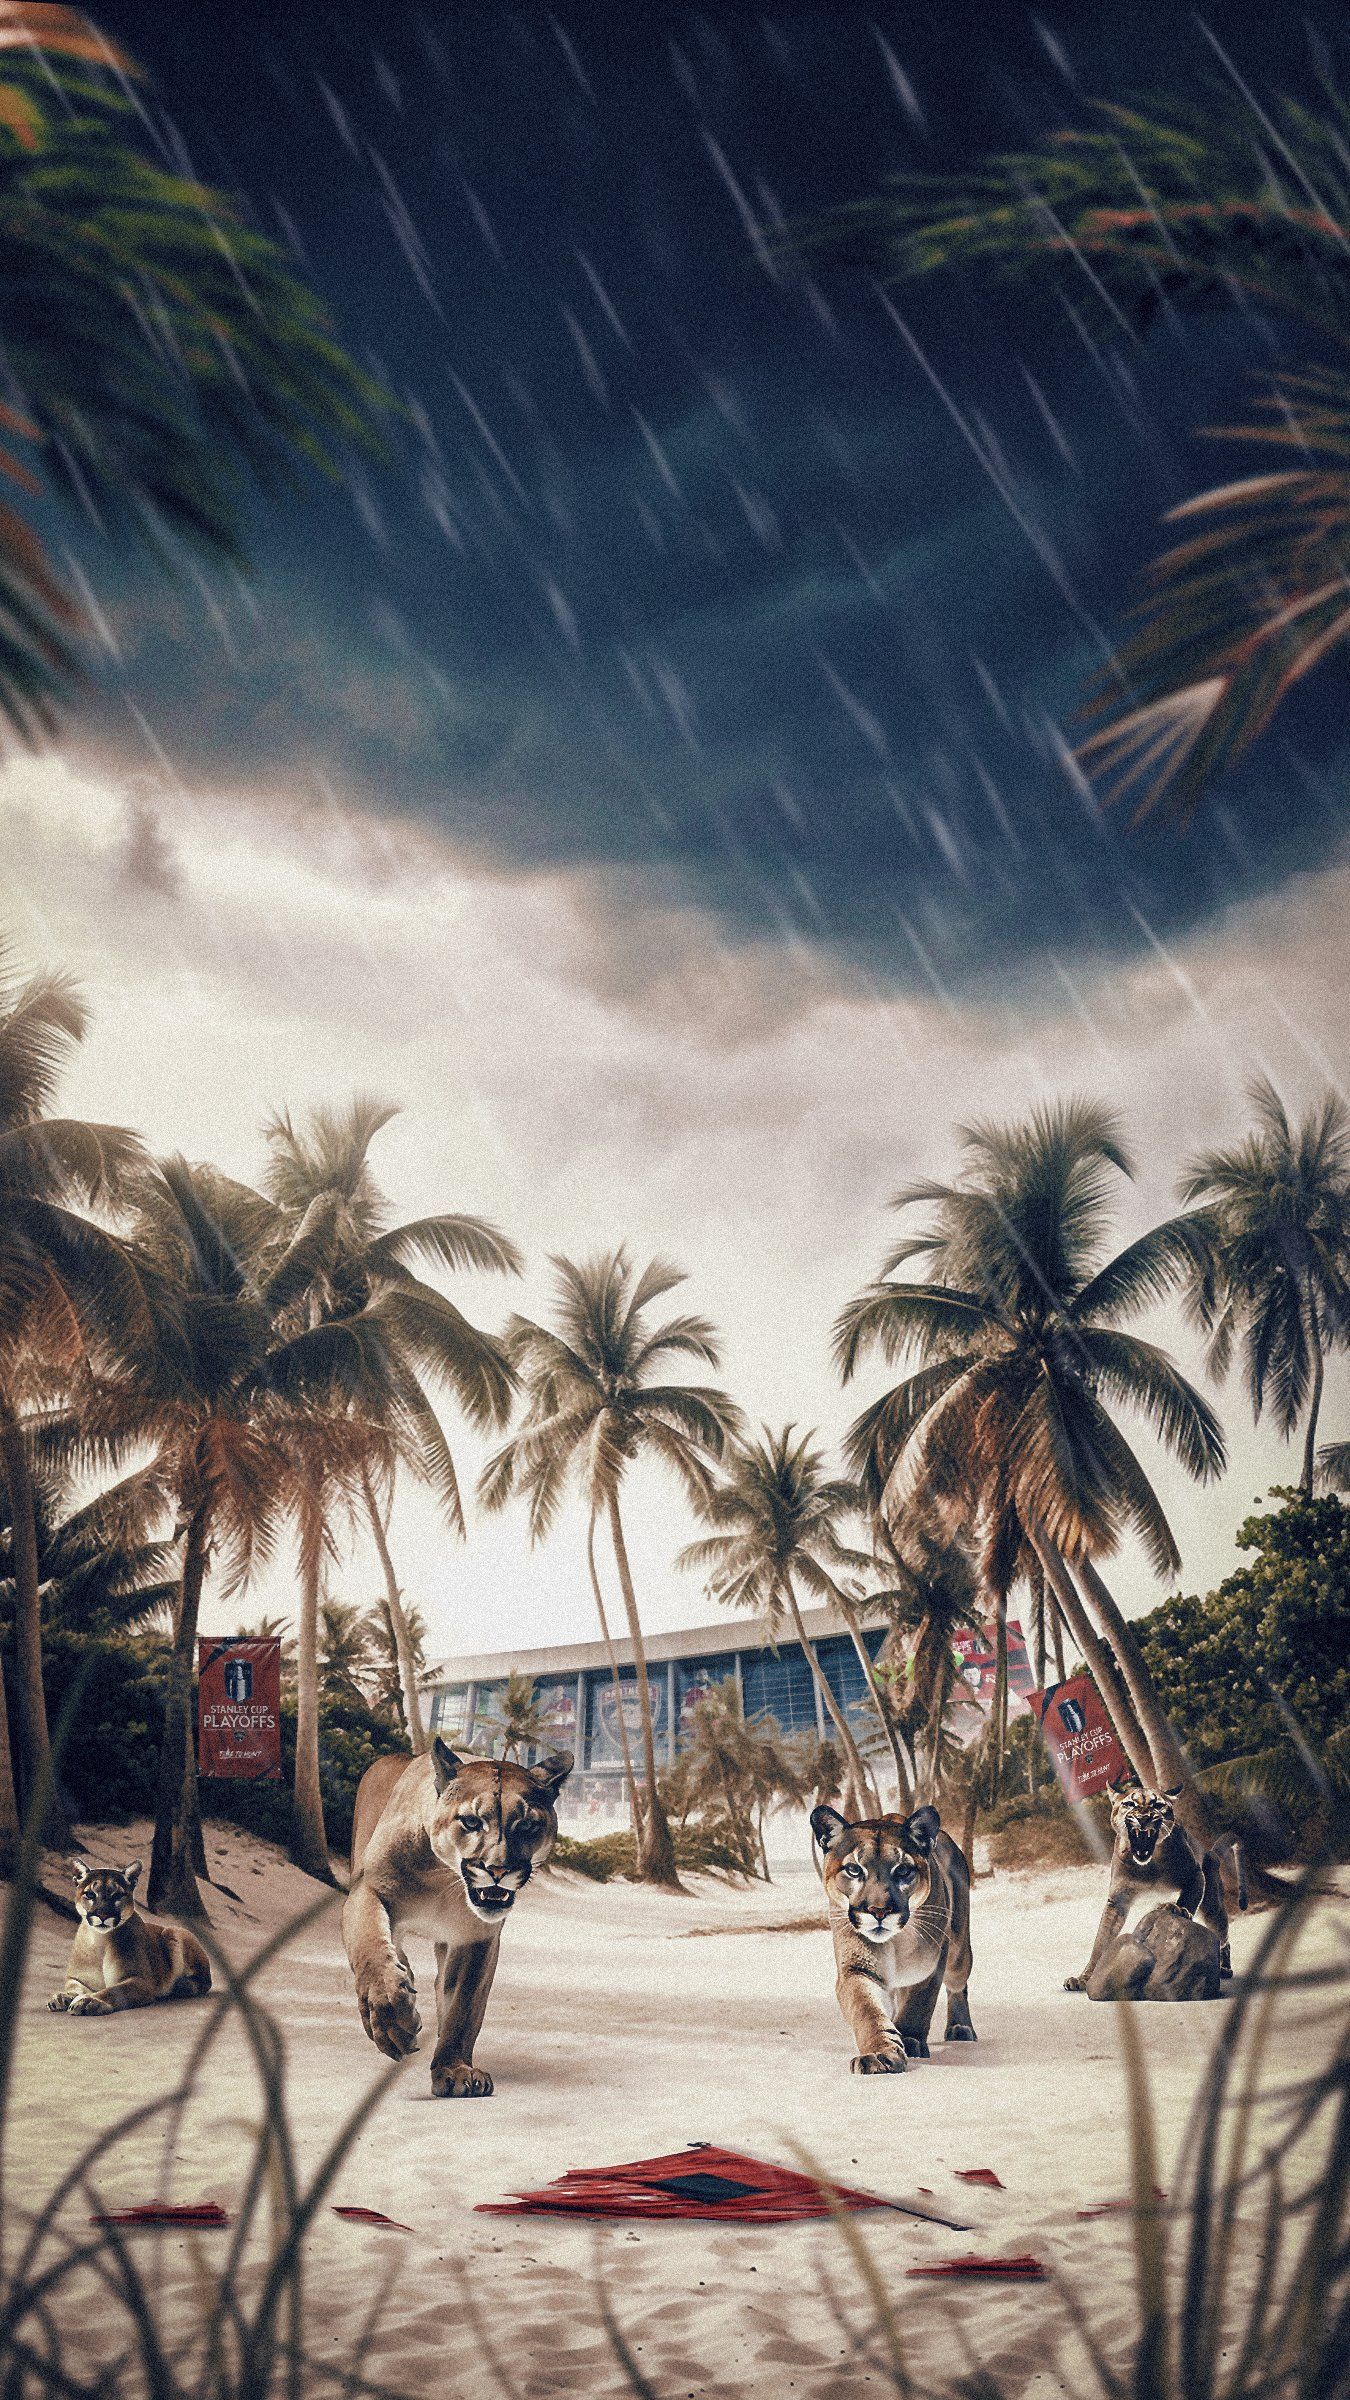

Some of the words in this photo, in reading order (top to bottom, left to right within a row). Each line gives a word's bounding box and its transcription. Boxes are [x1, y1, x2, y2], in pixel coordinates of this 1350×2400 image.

[210, 1705, 249, 1714] STANLEY
[250, 1705, 269, 1714] CUP
[203, 1715, 275, 1729] PLAYOFFS
[1060, 1732, 1089, 1750] STANLEY
[1089, 1726, 1103, 1737] CUP
[1056, 1732, 1112, 1764] PLAYOFFS
